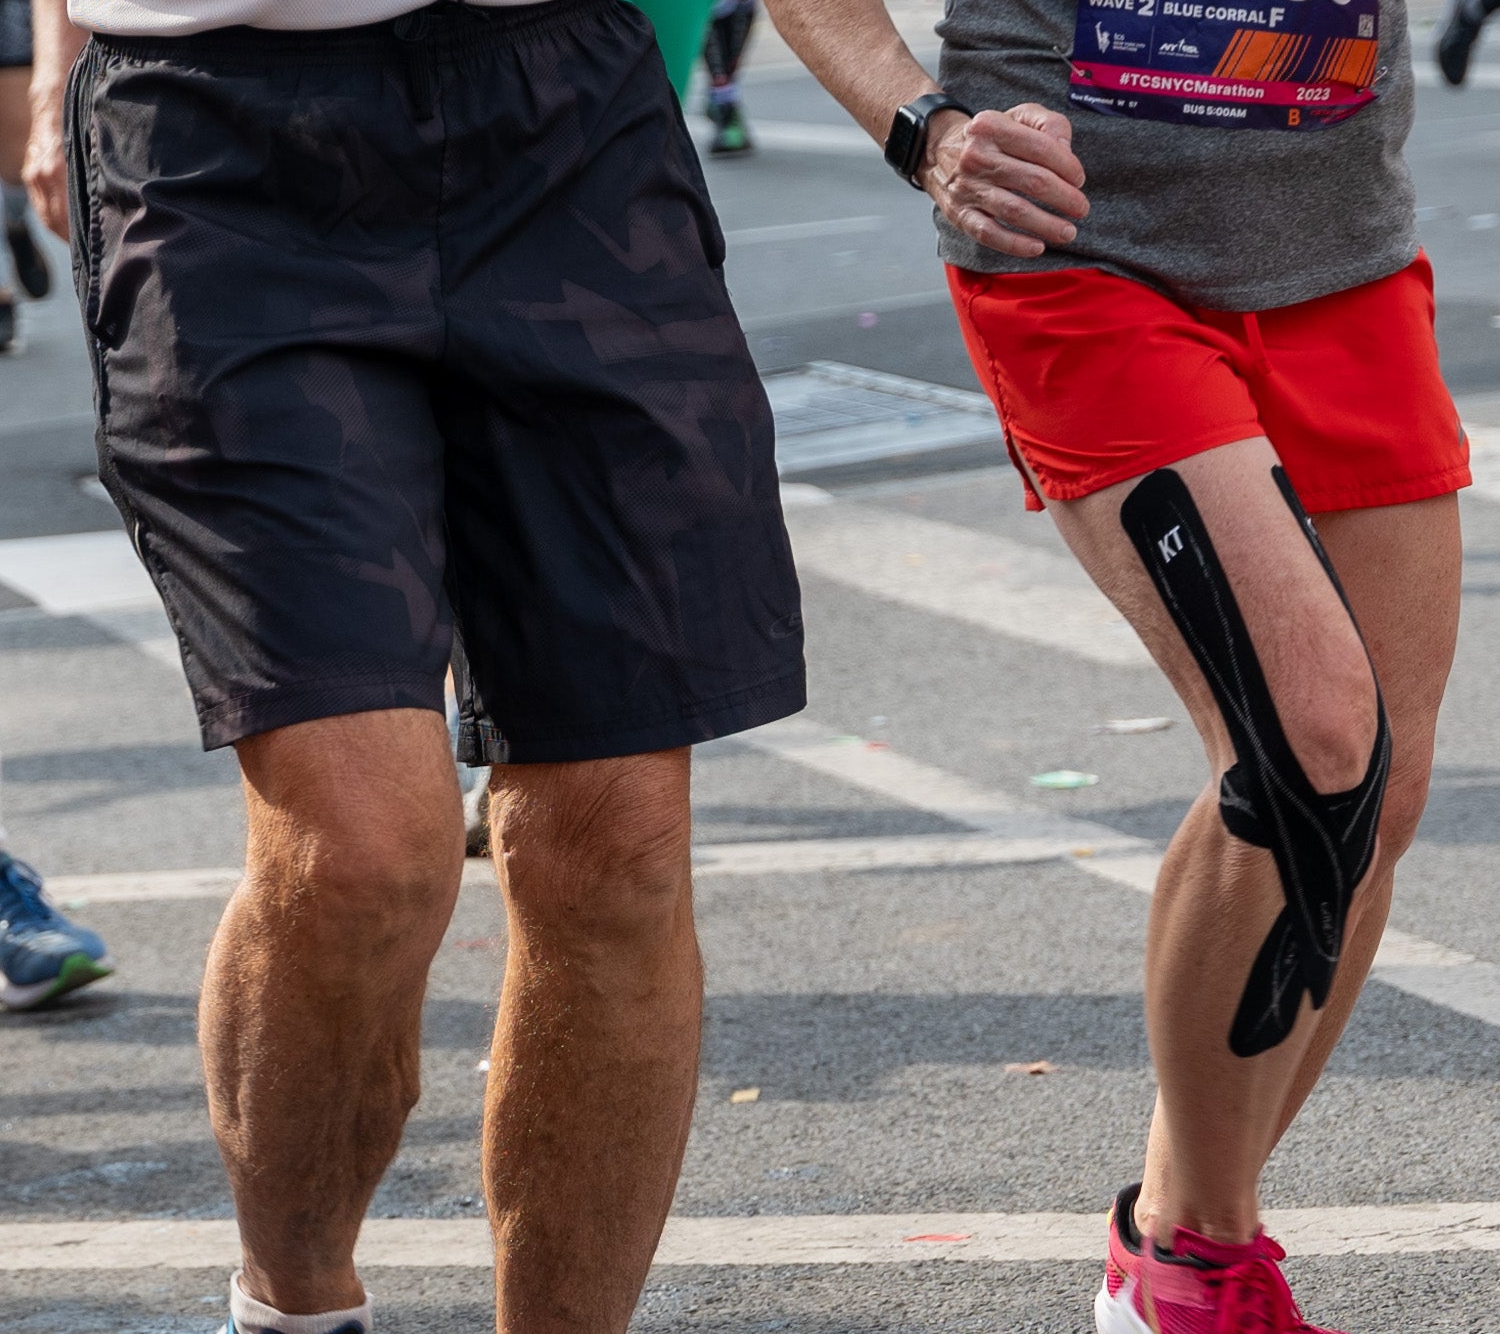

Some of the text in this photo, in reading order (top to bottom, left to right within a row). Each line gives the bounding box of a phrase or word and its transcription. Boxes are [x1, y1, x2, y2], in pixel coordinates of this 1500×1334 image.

[1163, 4, 1203, 18] BLUE
[1205, 6, 1267, 24] CORRAL
[1269, 7, 1285, 27] F
[1119, 72, 1265, 99] #TCSNYCMarathon
[1296, 87, 1331, 102] 2023
[1183, 103, 1248, 118] BUS 5:00AM
[1287, 108, 1300, 126] B
[1158, 524, 1184, 564] KT
